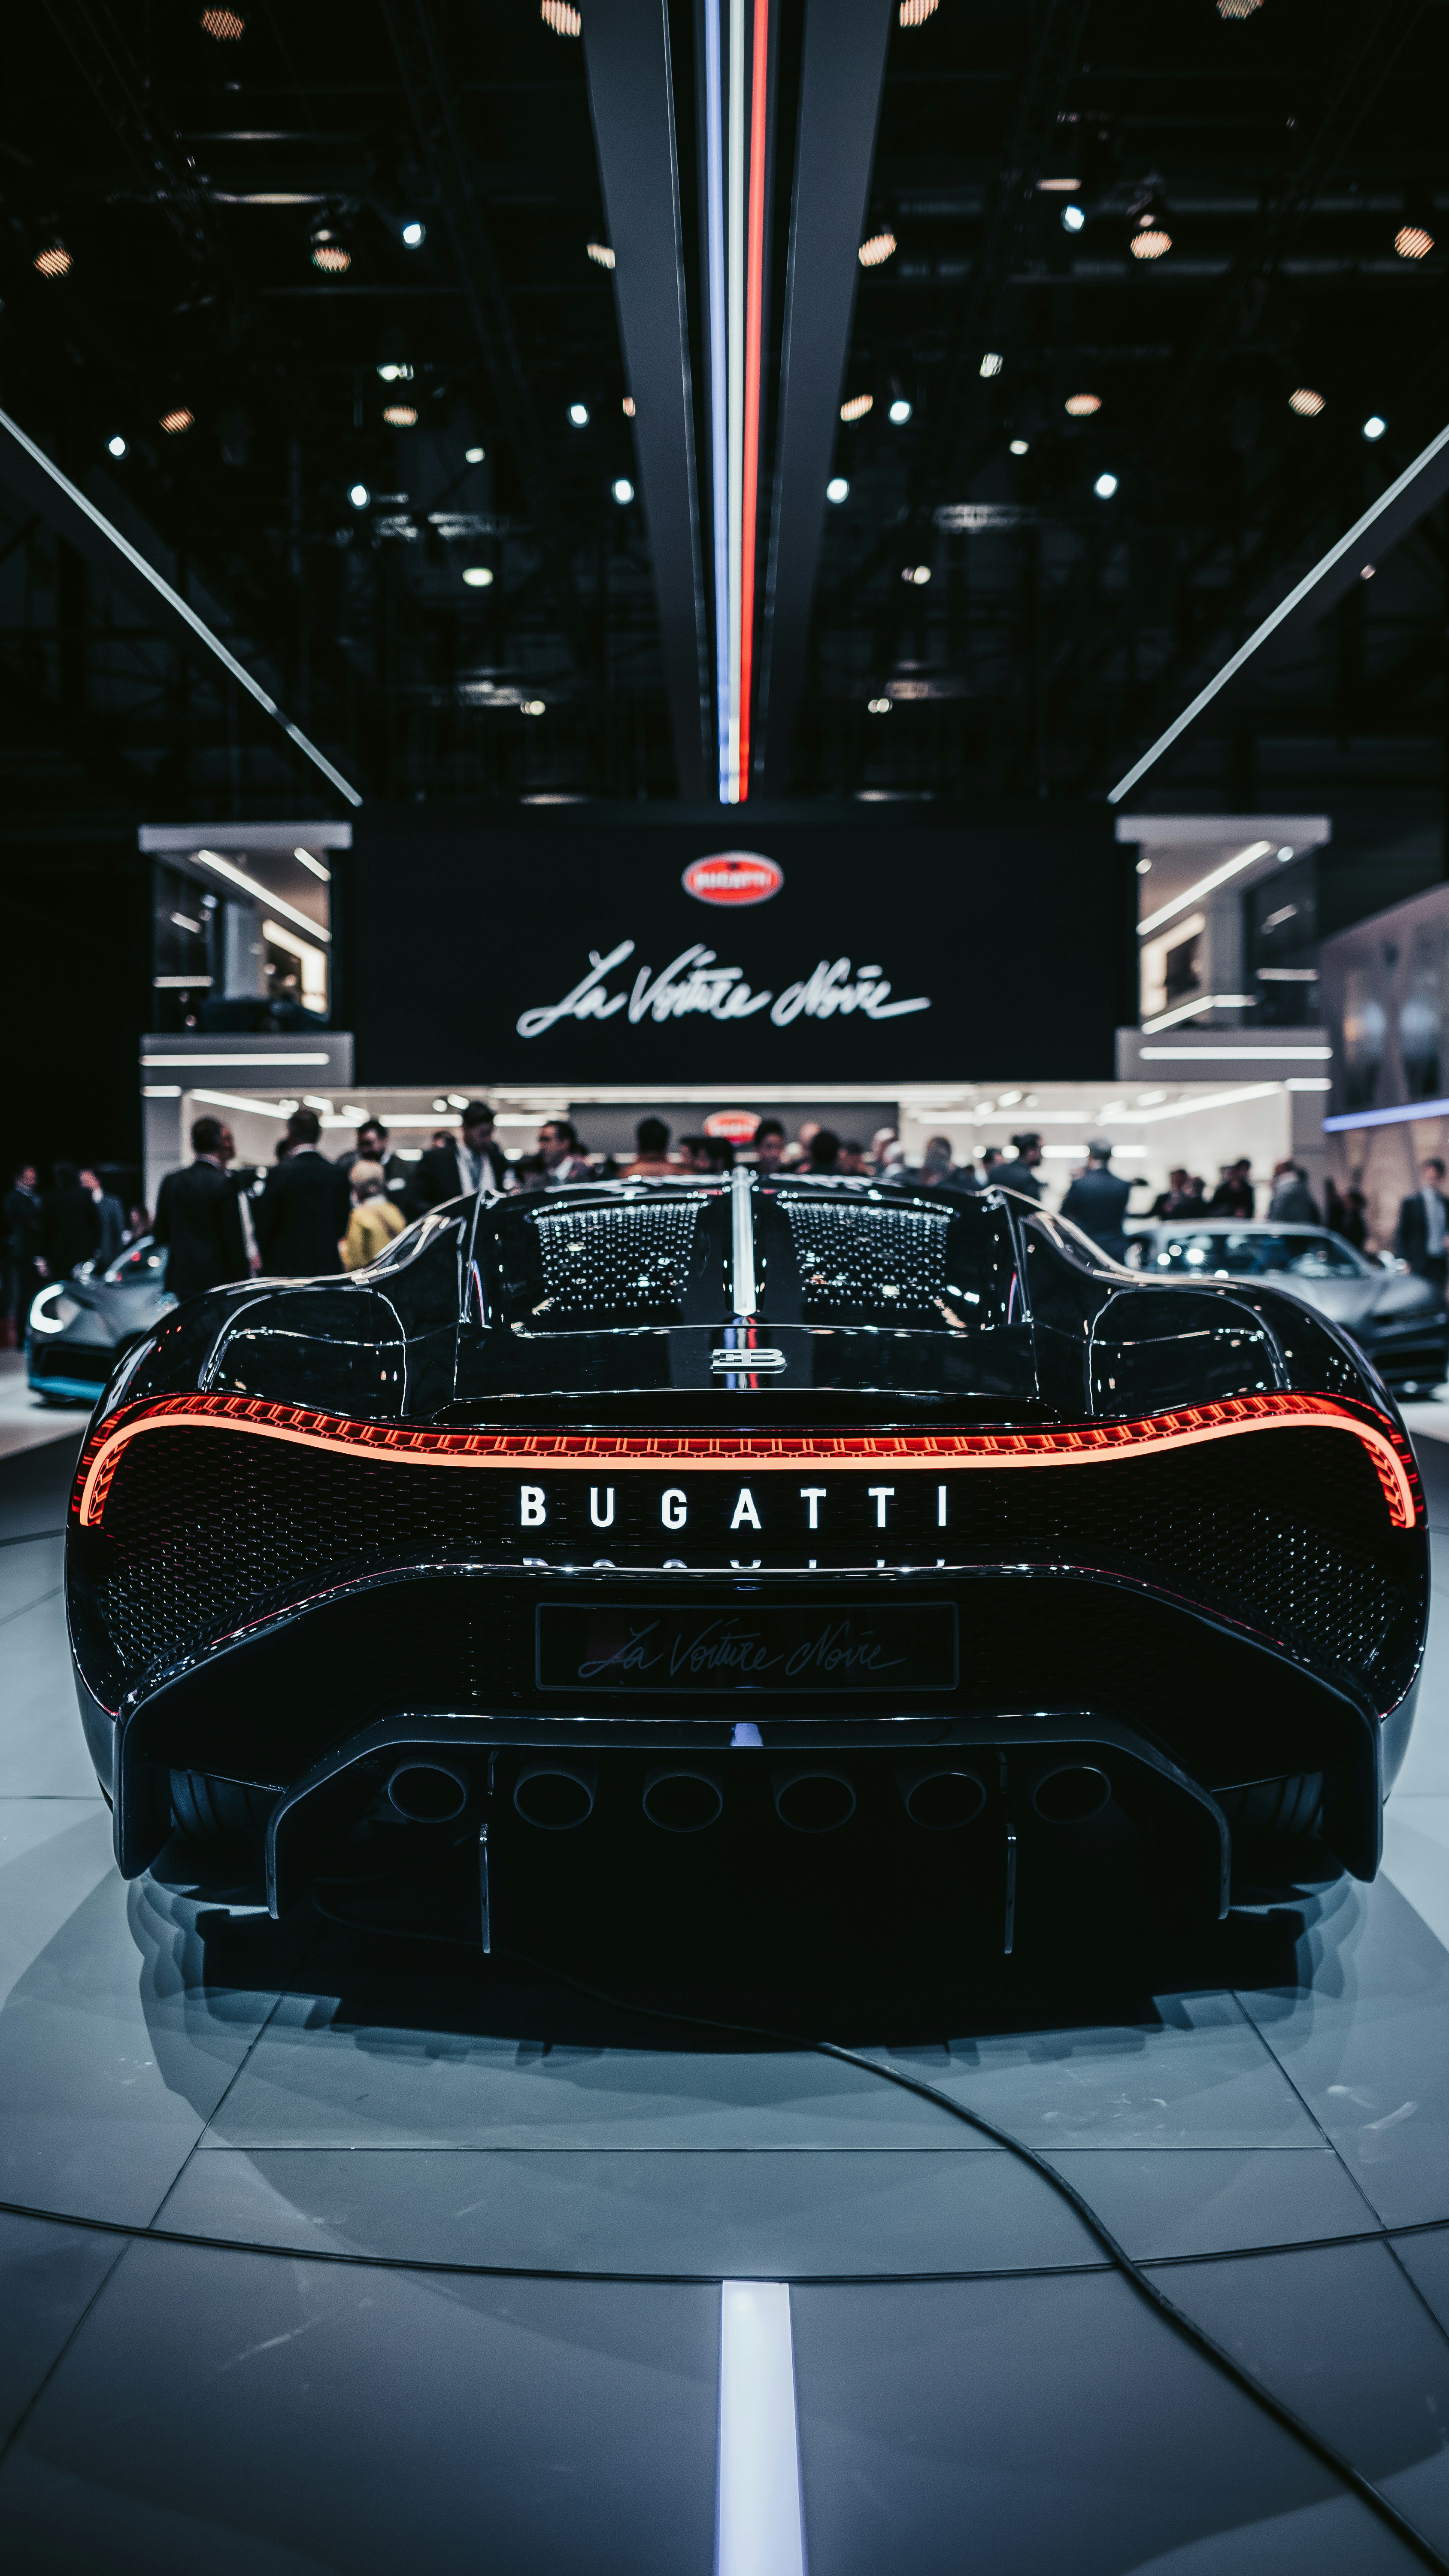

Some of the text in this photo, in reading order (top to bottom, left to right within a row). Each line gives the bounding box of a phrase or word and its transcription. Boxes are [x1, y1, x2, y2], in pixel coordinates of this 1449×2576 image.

[516, 939, 635, 1038] La
[521, 1485, 947, 1529] BUGATTI
[578, 1618, 907, 1678] La Voiture Noire
